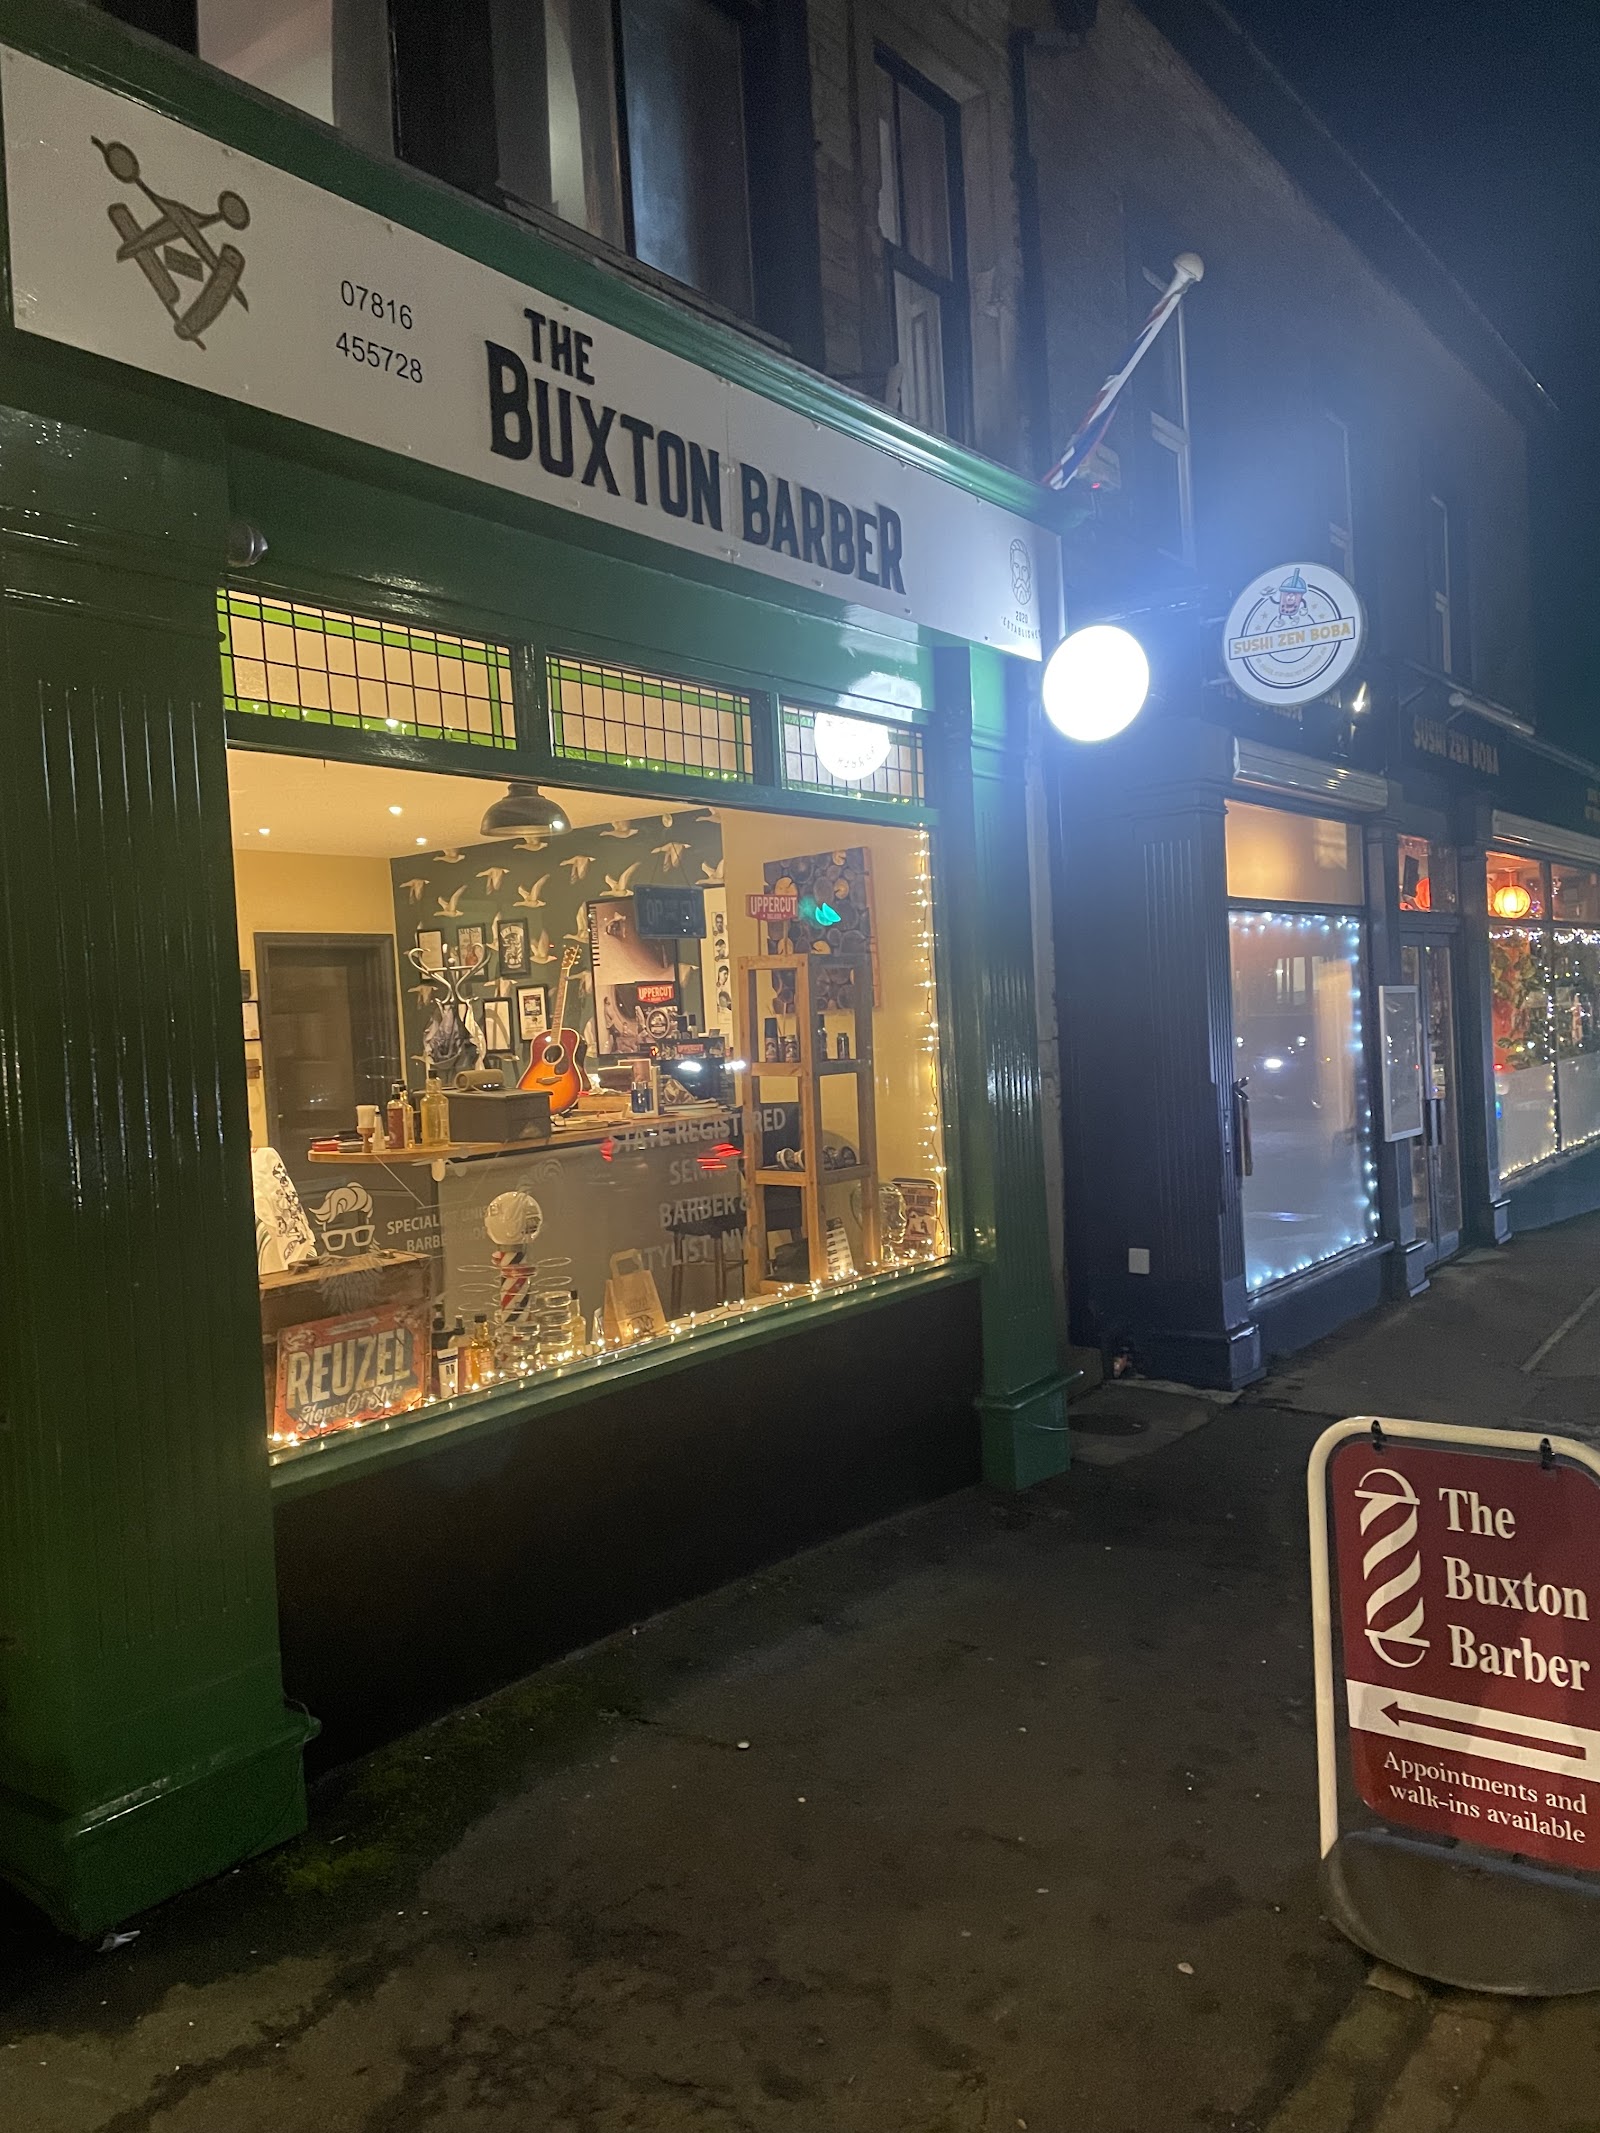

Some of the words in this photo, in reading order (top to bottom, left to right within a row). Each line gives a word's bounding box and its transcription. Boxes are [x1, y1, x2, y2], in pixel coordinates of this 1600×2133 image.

[341, 280, 412, 329] 07816
[336, 332, 422, 383] 455728
[524, 307, 596, 386] THE
[485, 340, 724, 532] BUXTON
[739, 462, 906, 595] BARBER
[1233, 636, 1273, 655] SUSHI
[1277, 630, 1305, 647] ZEN
[1310, 622, 1351, 641] BOBA
[750, 896, 797, 915] UPPERCUT
[638, 987, 673, 1000] UPPERCUT
[676, 1108, 786, 1145] REGISTRED
[659, 1196, 735, 1228] BARBER
[634, 1235, 711, 1270] TYLIST
[287, 1328, 410, 1410] REUZEL
[1439, 1487, 1516, 1539] The
[1443, 1556, 1590, 1621] Buxton
[1447, 1624, 1590, 1691] Barber
[1384, 1751, 1538, 1803] Appointments
[1545, 1794, 1588, 1814] and
[1389, 1784, 1480, 1818] walk-ins
[1487, 1811, 1586, 1843] available
